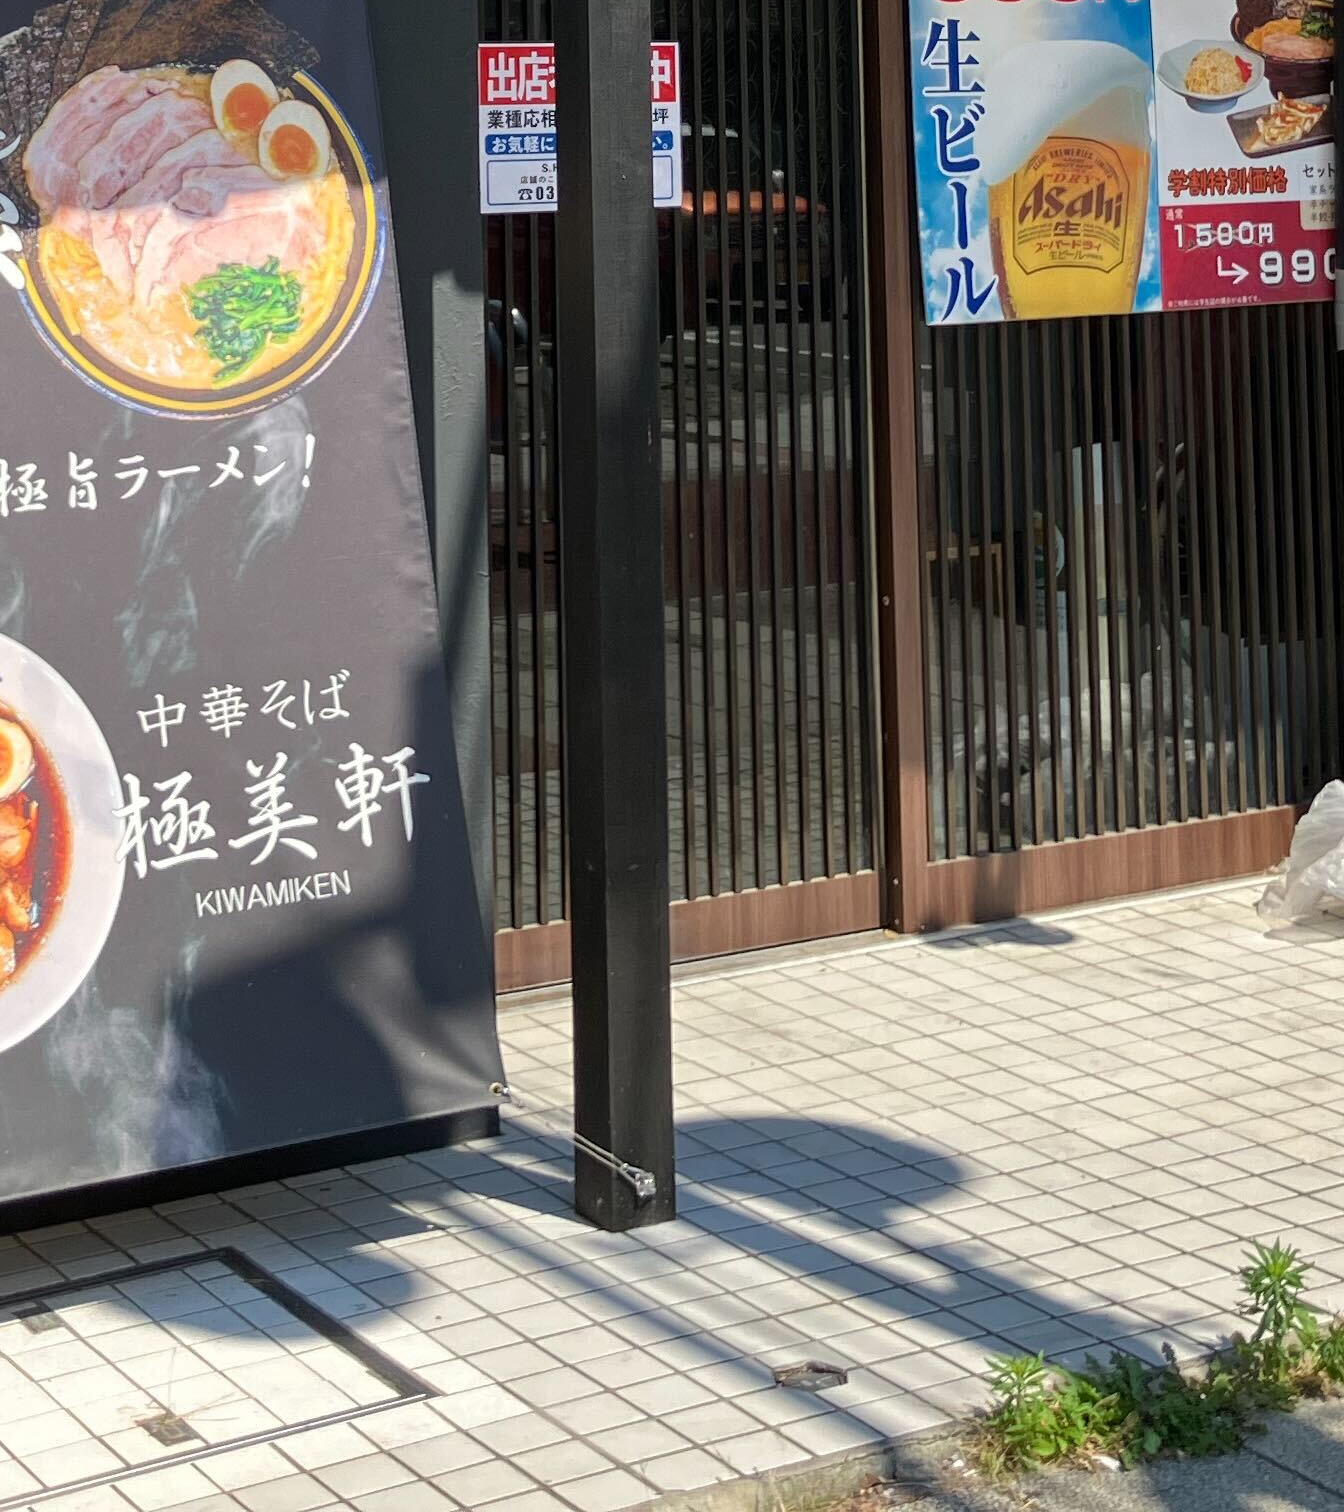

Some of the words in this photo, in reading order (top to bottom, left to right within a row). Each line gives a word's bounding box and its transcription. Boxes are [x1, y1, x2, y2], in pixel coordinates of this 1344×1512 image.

[921, 17, 999, 321] 生ビール
[1167, 166, 1288, 197] 学割特別価格
[1018, 176, 1123, 230] Asahi
[1054, 220, 1082, 236] 生
[137, 668, 352, 749] 中華そば
[112, 741, 432, 880] 極美軒
[194, 870, 352, 919] KIWAMIKEN
